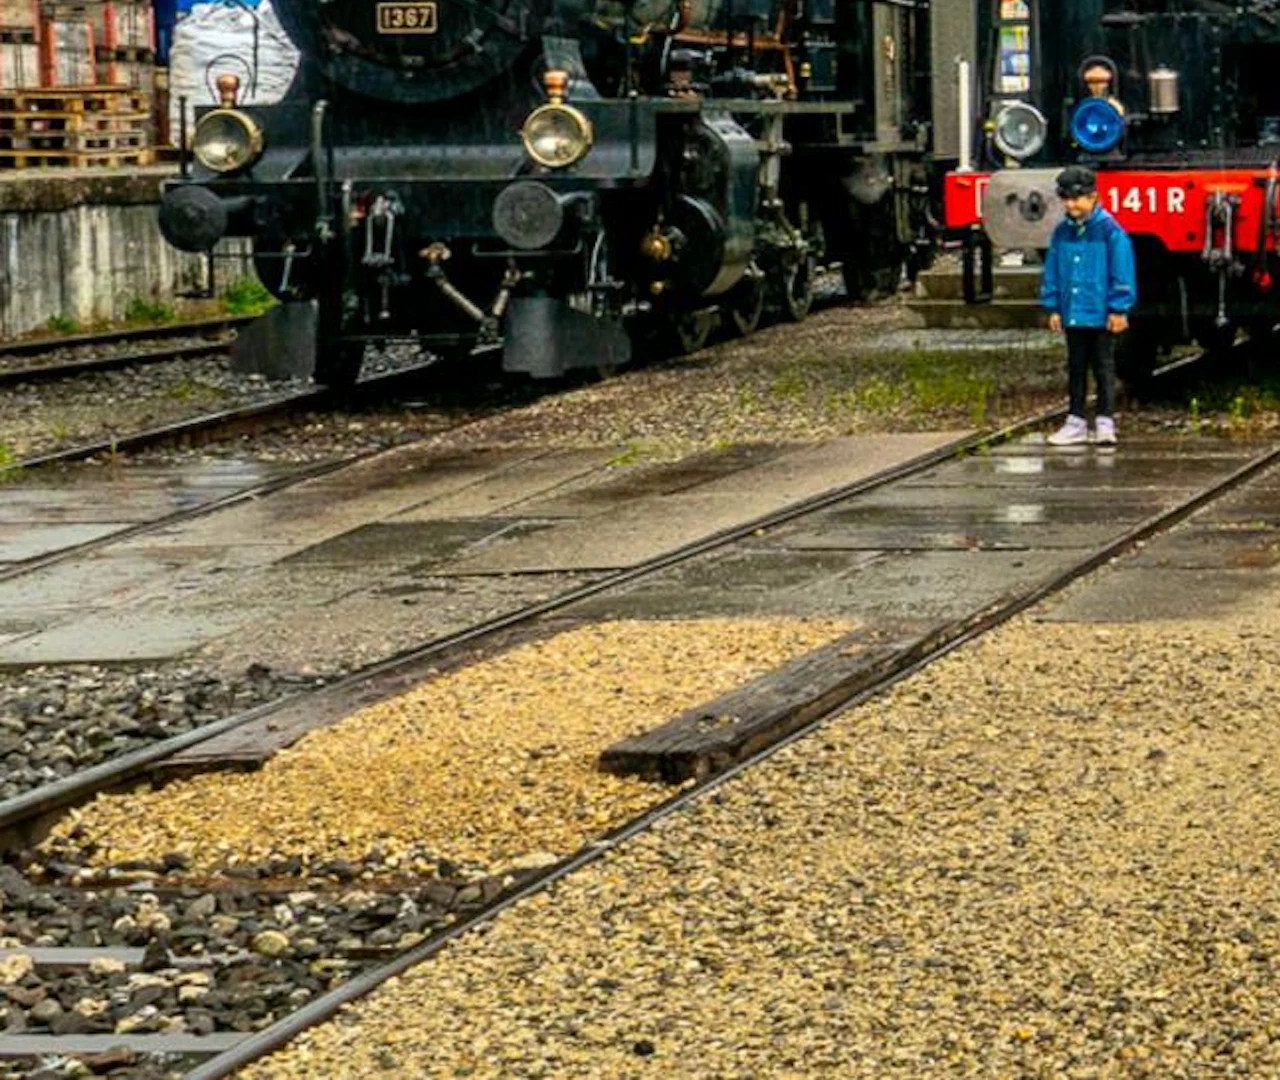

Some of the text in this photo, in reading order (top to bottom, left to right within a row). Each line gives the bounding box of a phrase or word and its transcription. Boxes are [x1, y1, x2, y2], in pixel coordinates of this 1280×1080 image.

[384, 7, 431, 28] 1367
[1108, 186, 1157, 213] 141
[1166, 186, 1185, 213] R
